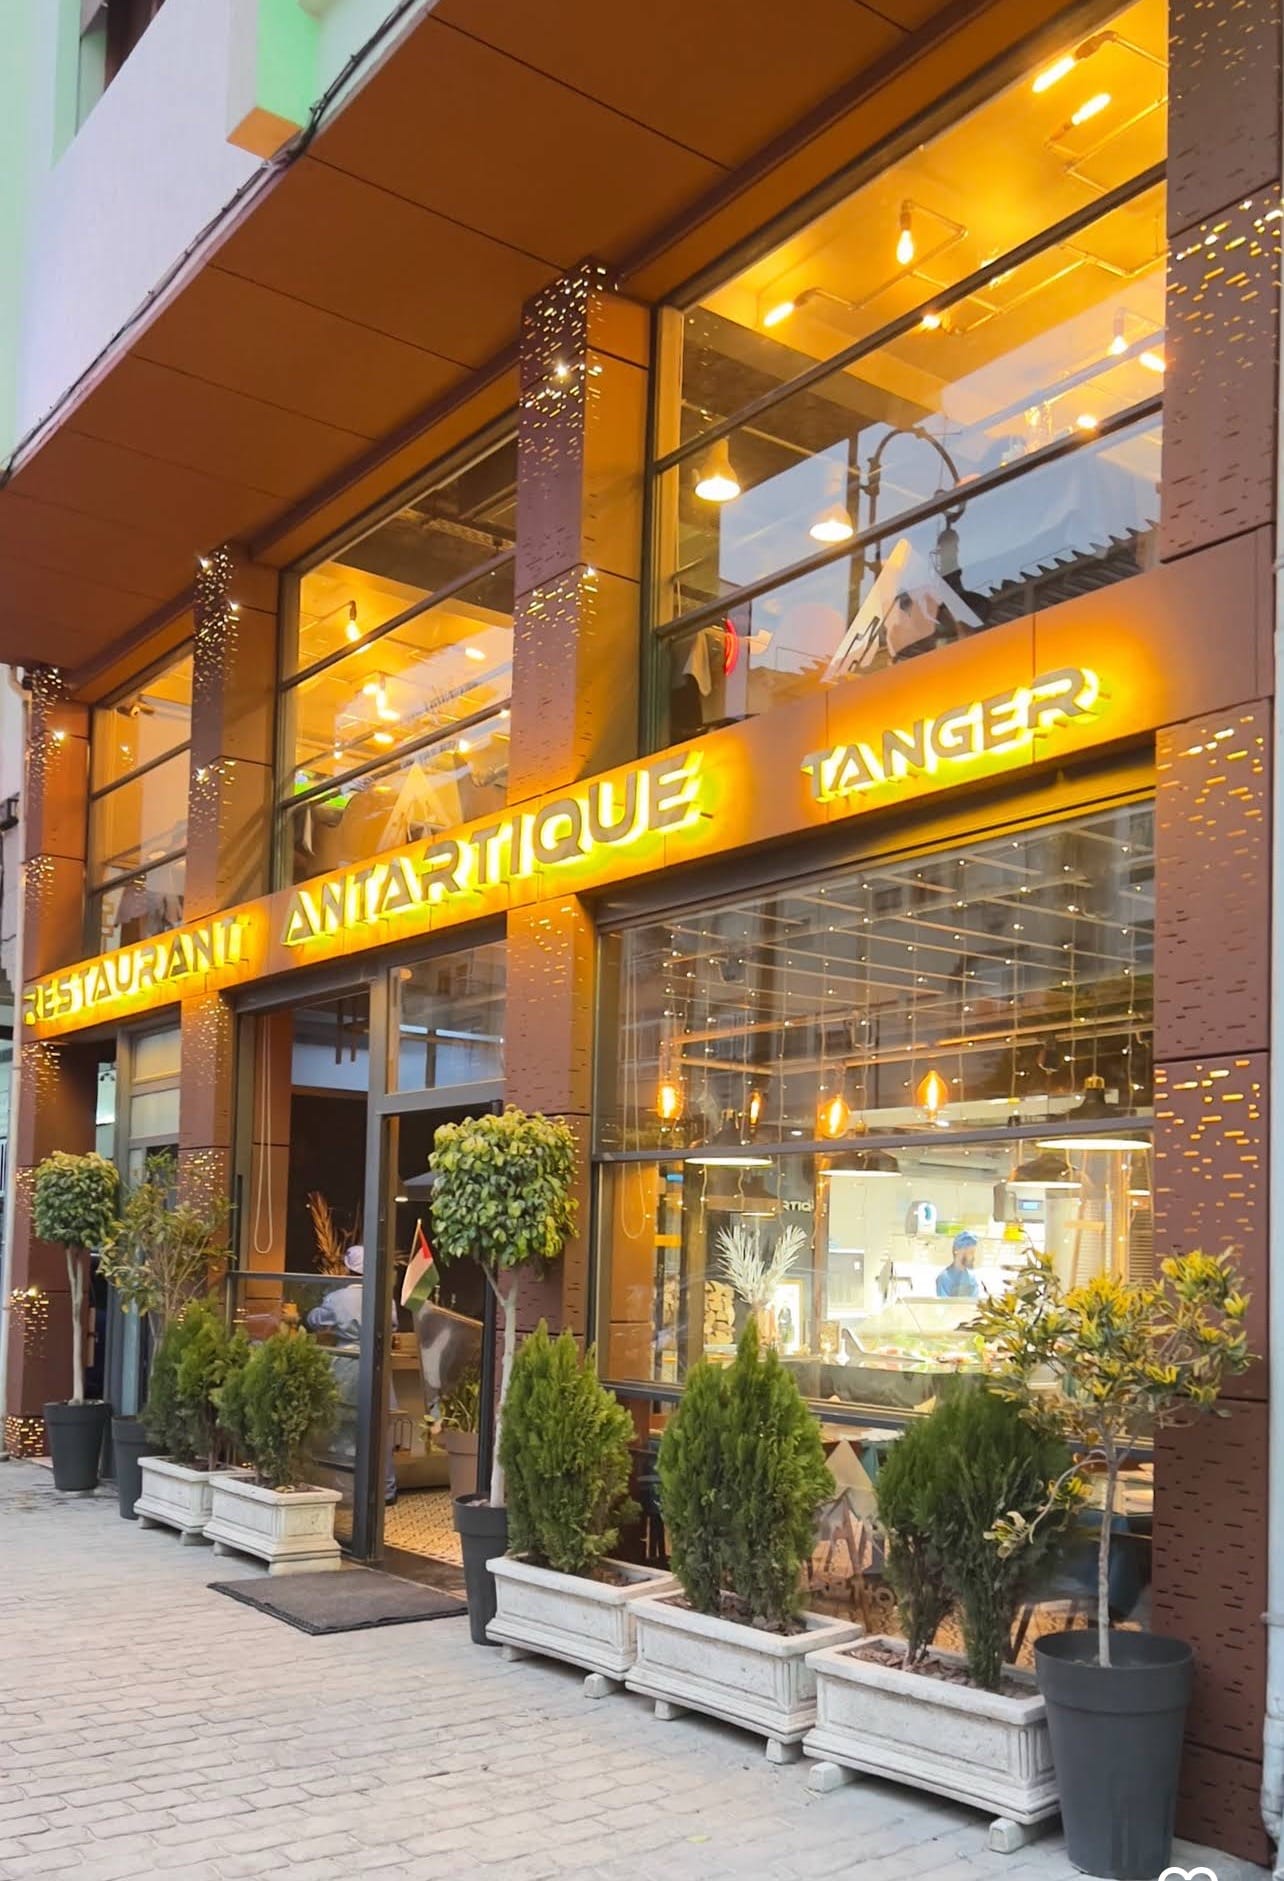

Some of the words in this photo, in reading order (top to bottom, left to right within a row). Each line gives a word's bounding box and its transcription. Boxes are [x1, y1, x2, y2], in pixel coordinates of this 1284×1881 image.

[23, 914, 248, 1020] RESTAURANT
[281, 751, 702, 946] ANTARTIQUE
[800, 667, 1098, 802] TANGER
